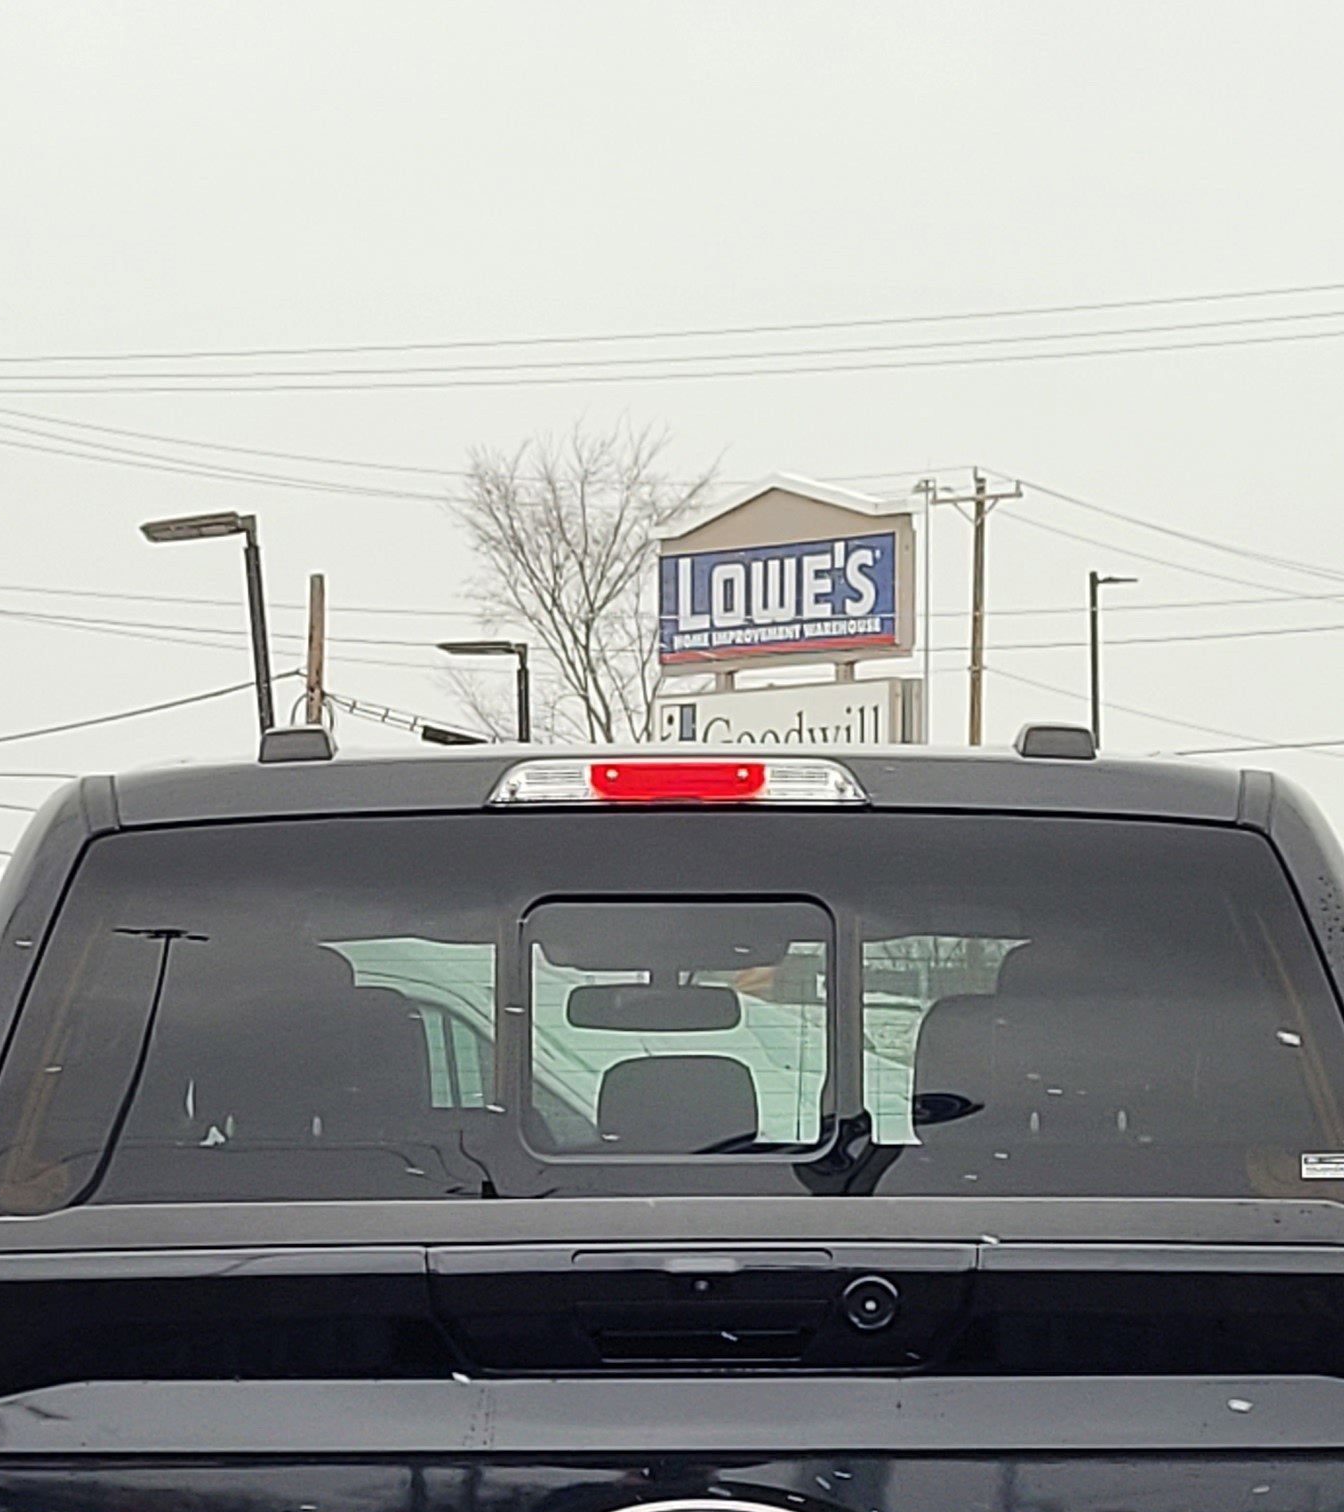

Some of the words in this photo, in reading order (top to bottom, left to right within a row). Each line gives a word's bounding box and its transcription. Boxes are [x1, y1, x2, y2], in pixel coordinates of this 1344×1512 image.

[677, 541, 878, 632] LOWE'S
[673, 632, 710, 650] HOME
[712, 623, 801, 647] IMPROVEMENT
[803, 617, 882, 638] WAREHOUSE
